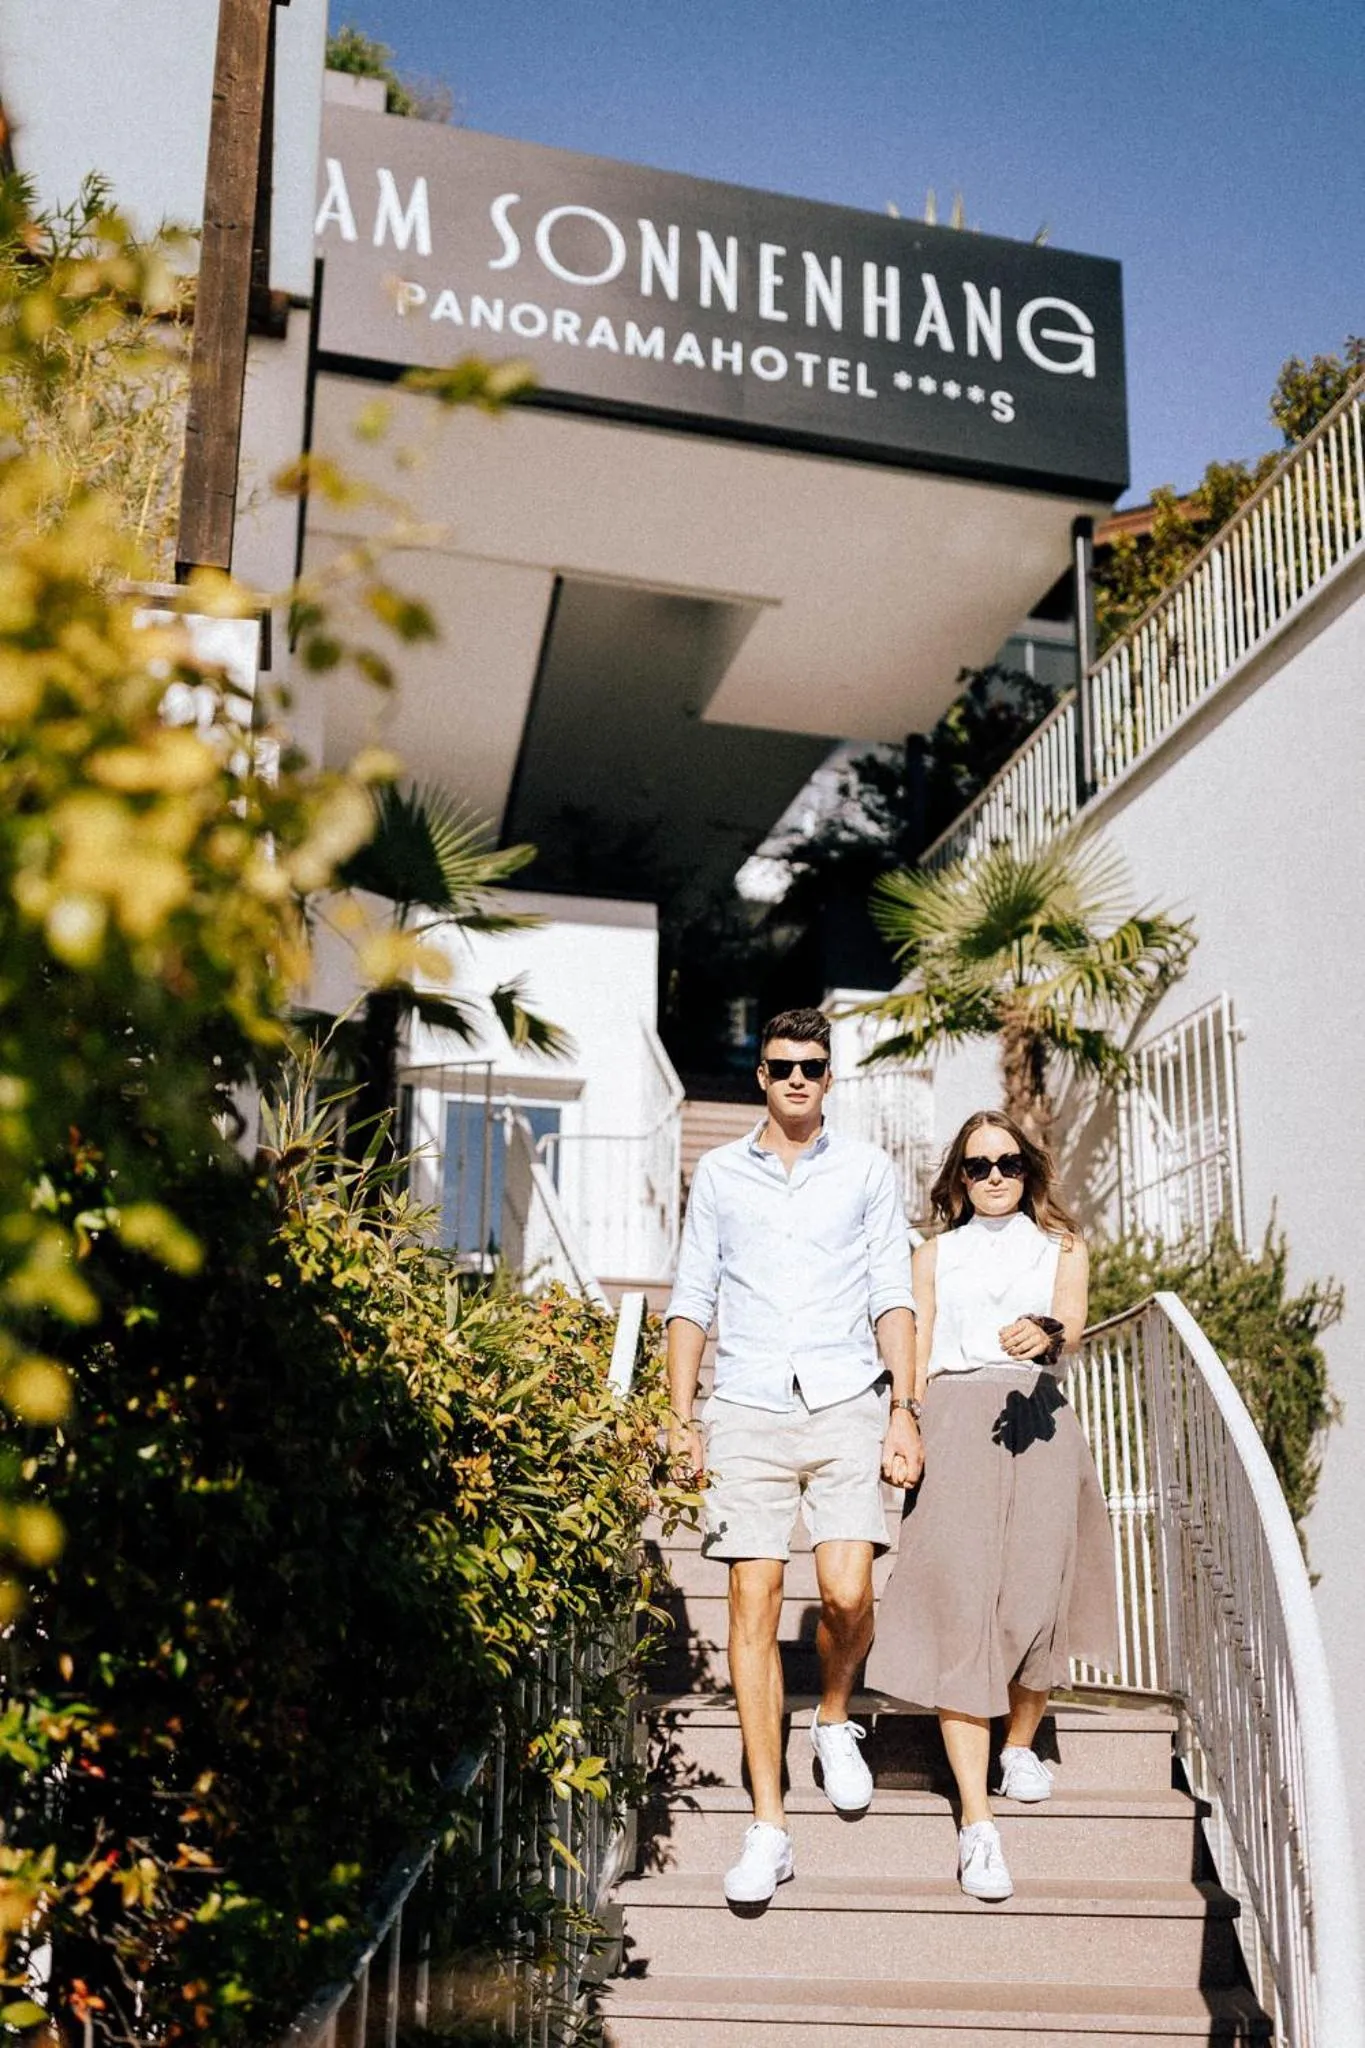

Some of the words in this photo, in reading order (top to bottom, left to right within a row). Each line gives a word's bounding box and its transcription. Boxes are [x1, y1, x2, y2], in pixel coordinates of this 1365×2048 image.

[314, 157, 433, 257] AM
[488, 192, 1097, 380] SONNENHANG
[396, 280, 879, 400] PANORAMAHOTEL
